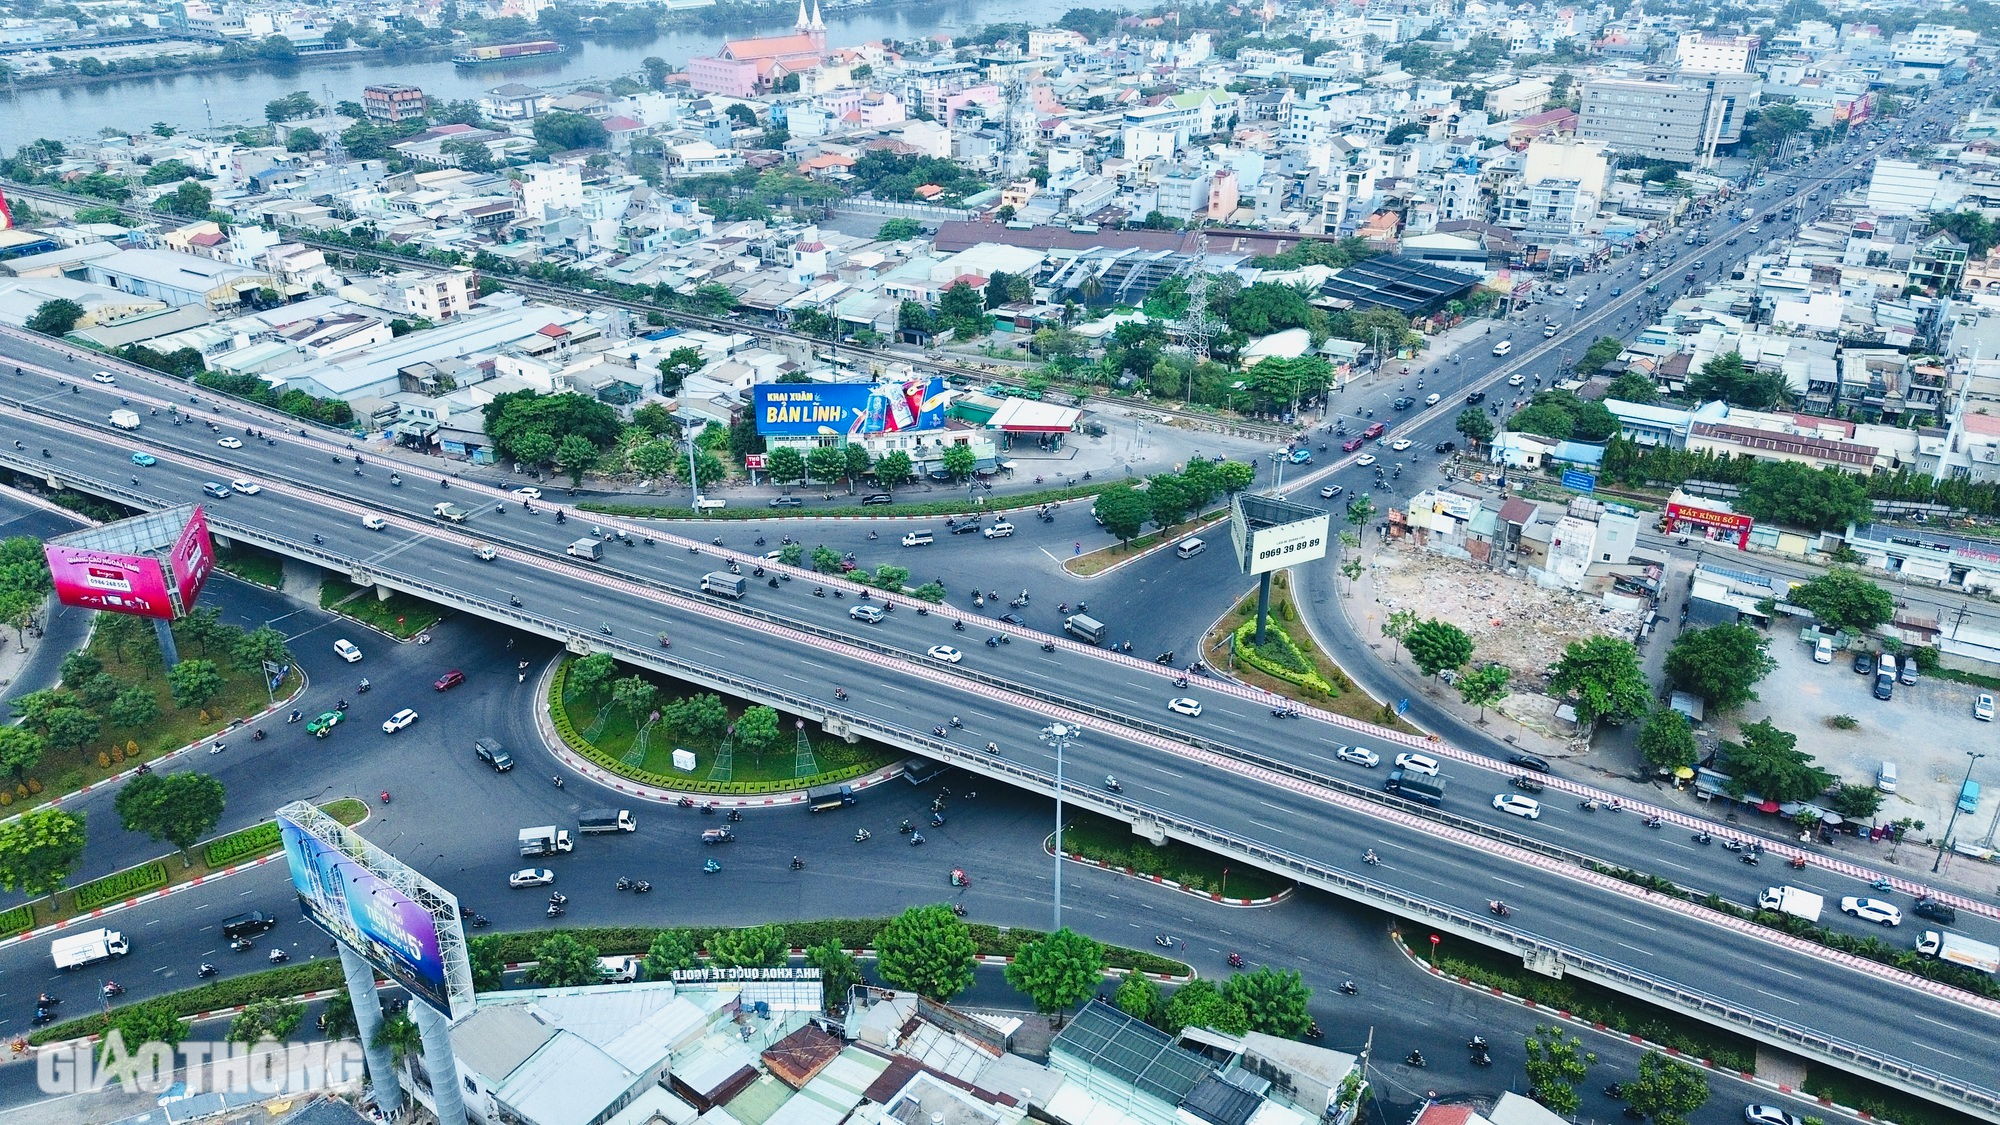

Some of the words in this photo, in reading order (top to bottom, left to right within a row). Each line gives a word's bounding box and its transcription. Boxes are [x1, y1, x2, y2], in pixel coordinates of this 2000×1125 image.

[766, 392, 788, 402] KHAI
[790, 391, 813, 402] XUÂN
[766, 402, 801, 423] BẢN
[802, 402, 841, 423] LĨNH
